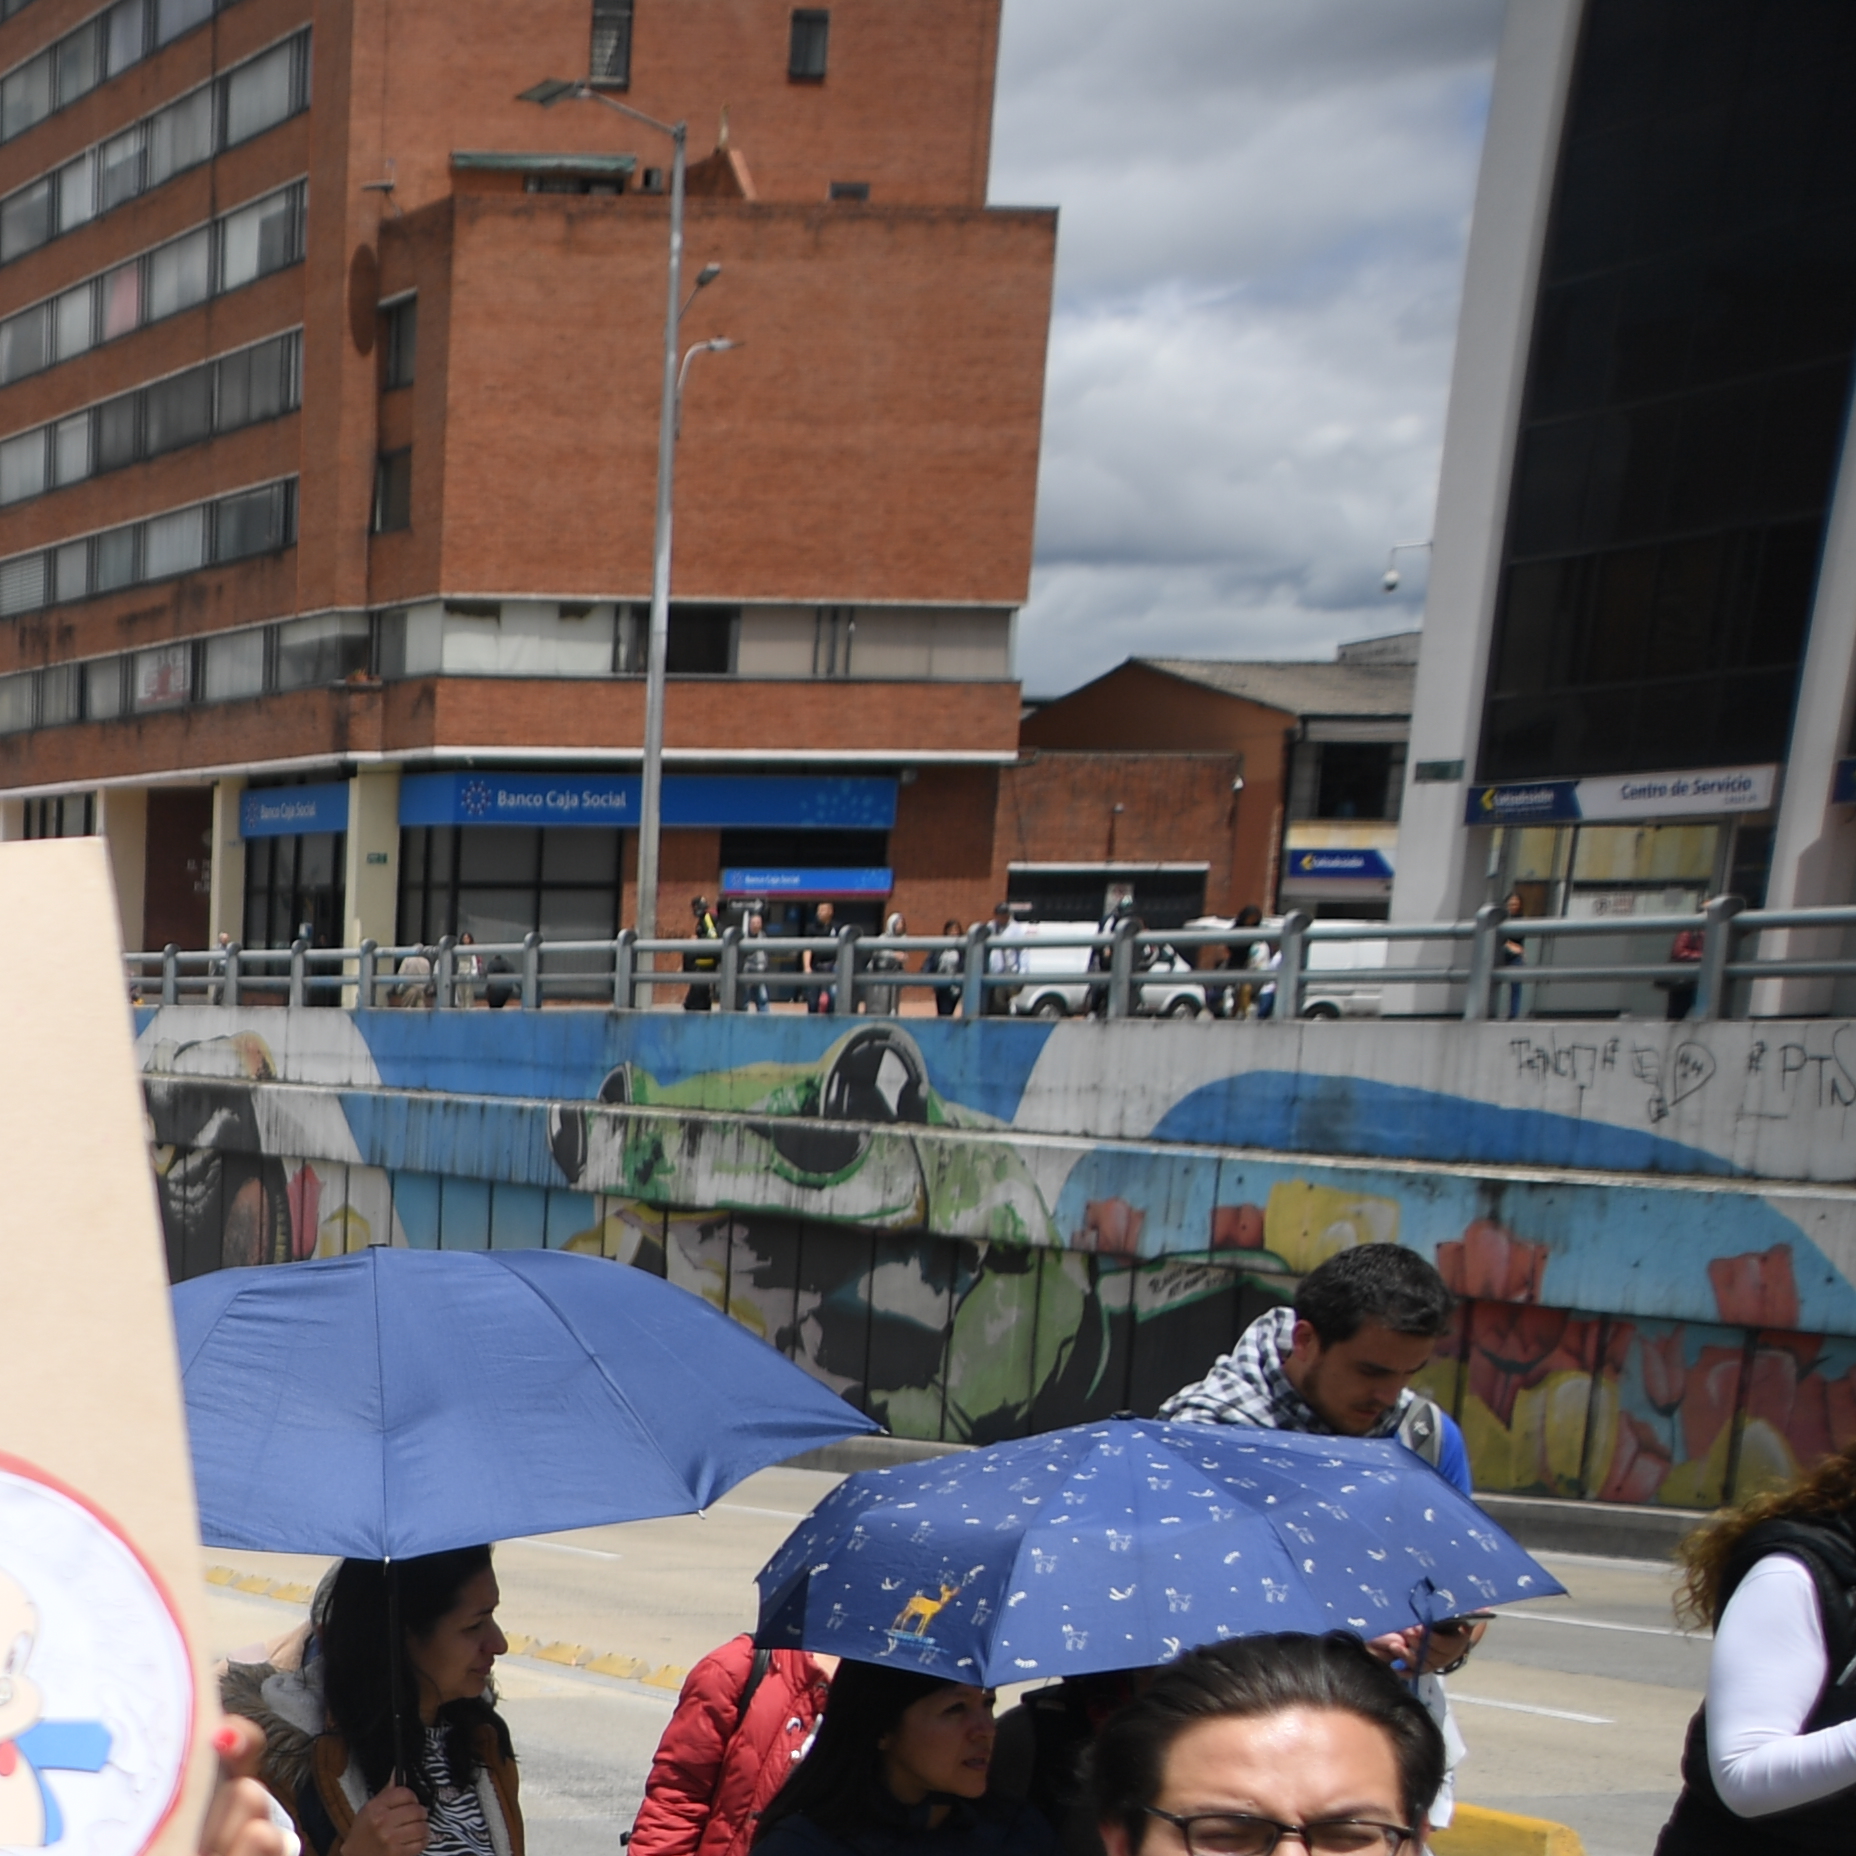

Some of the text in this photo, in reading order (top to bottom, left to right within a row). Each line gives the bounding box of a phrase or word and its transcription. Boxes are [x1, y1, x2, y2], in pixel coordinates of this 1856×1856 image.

[1621, 773, 1752, 800] Centro de Servicio
[497, 788, 627, 810] Banco Caja Social
